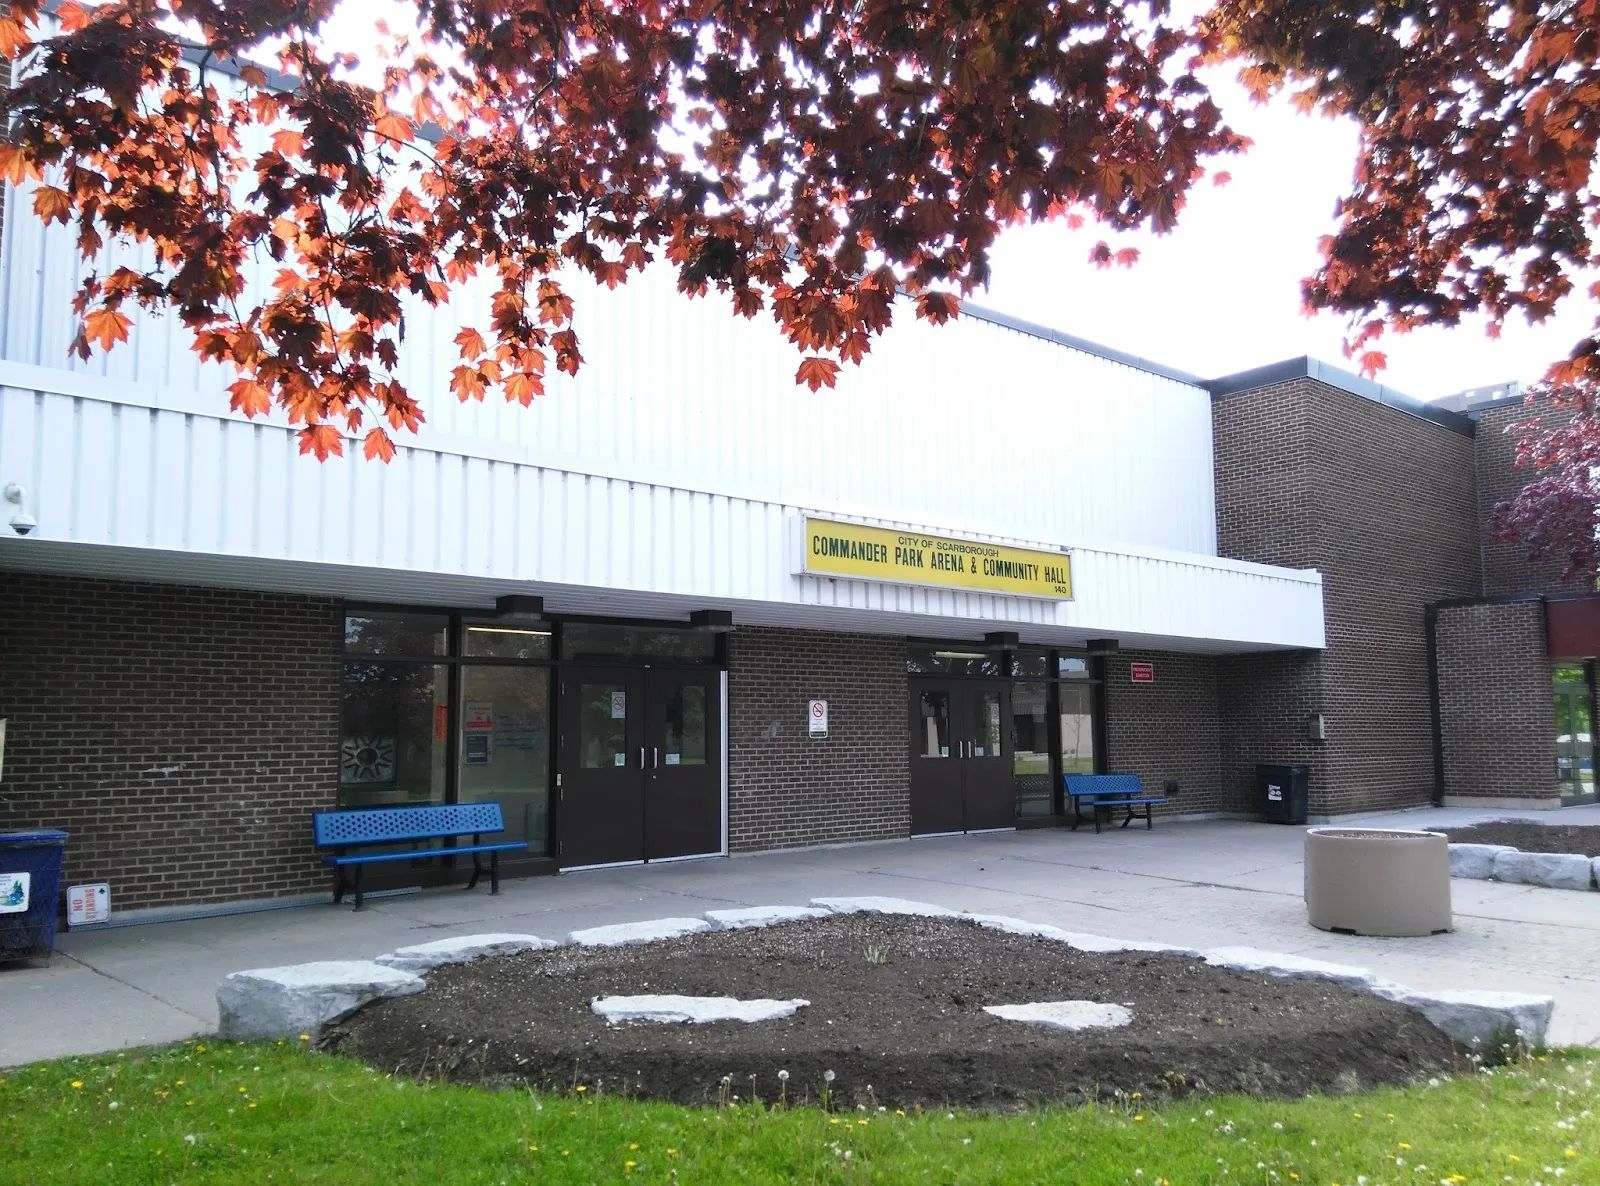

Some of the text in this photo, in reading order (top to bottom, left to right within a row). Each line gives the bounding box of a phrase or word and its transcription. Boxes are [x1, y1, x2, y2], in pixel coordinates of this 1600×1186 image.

[898, 536, 999, 557] CITY OF SCARBOROUGH
[813, 535, 1067, 584] COMMANDER PARK ARENA & COMMUNITY HALL
[1054, 585, 1067, 594] 140
[72, 899, 83, 912] NO
[85, 888, 96, 920] STANDING
